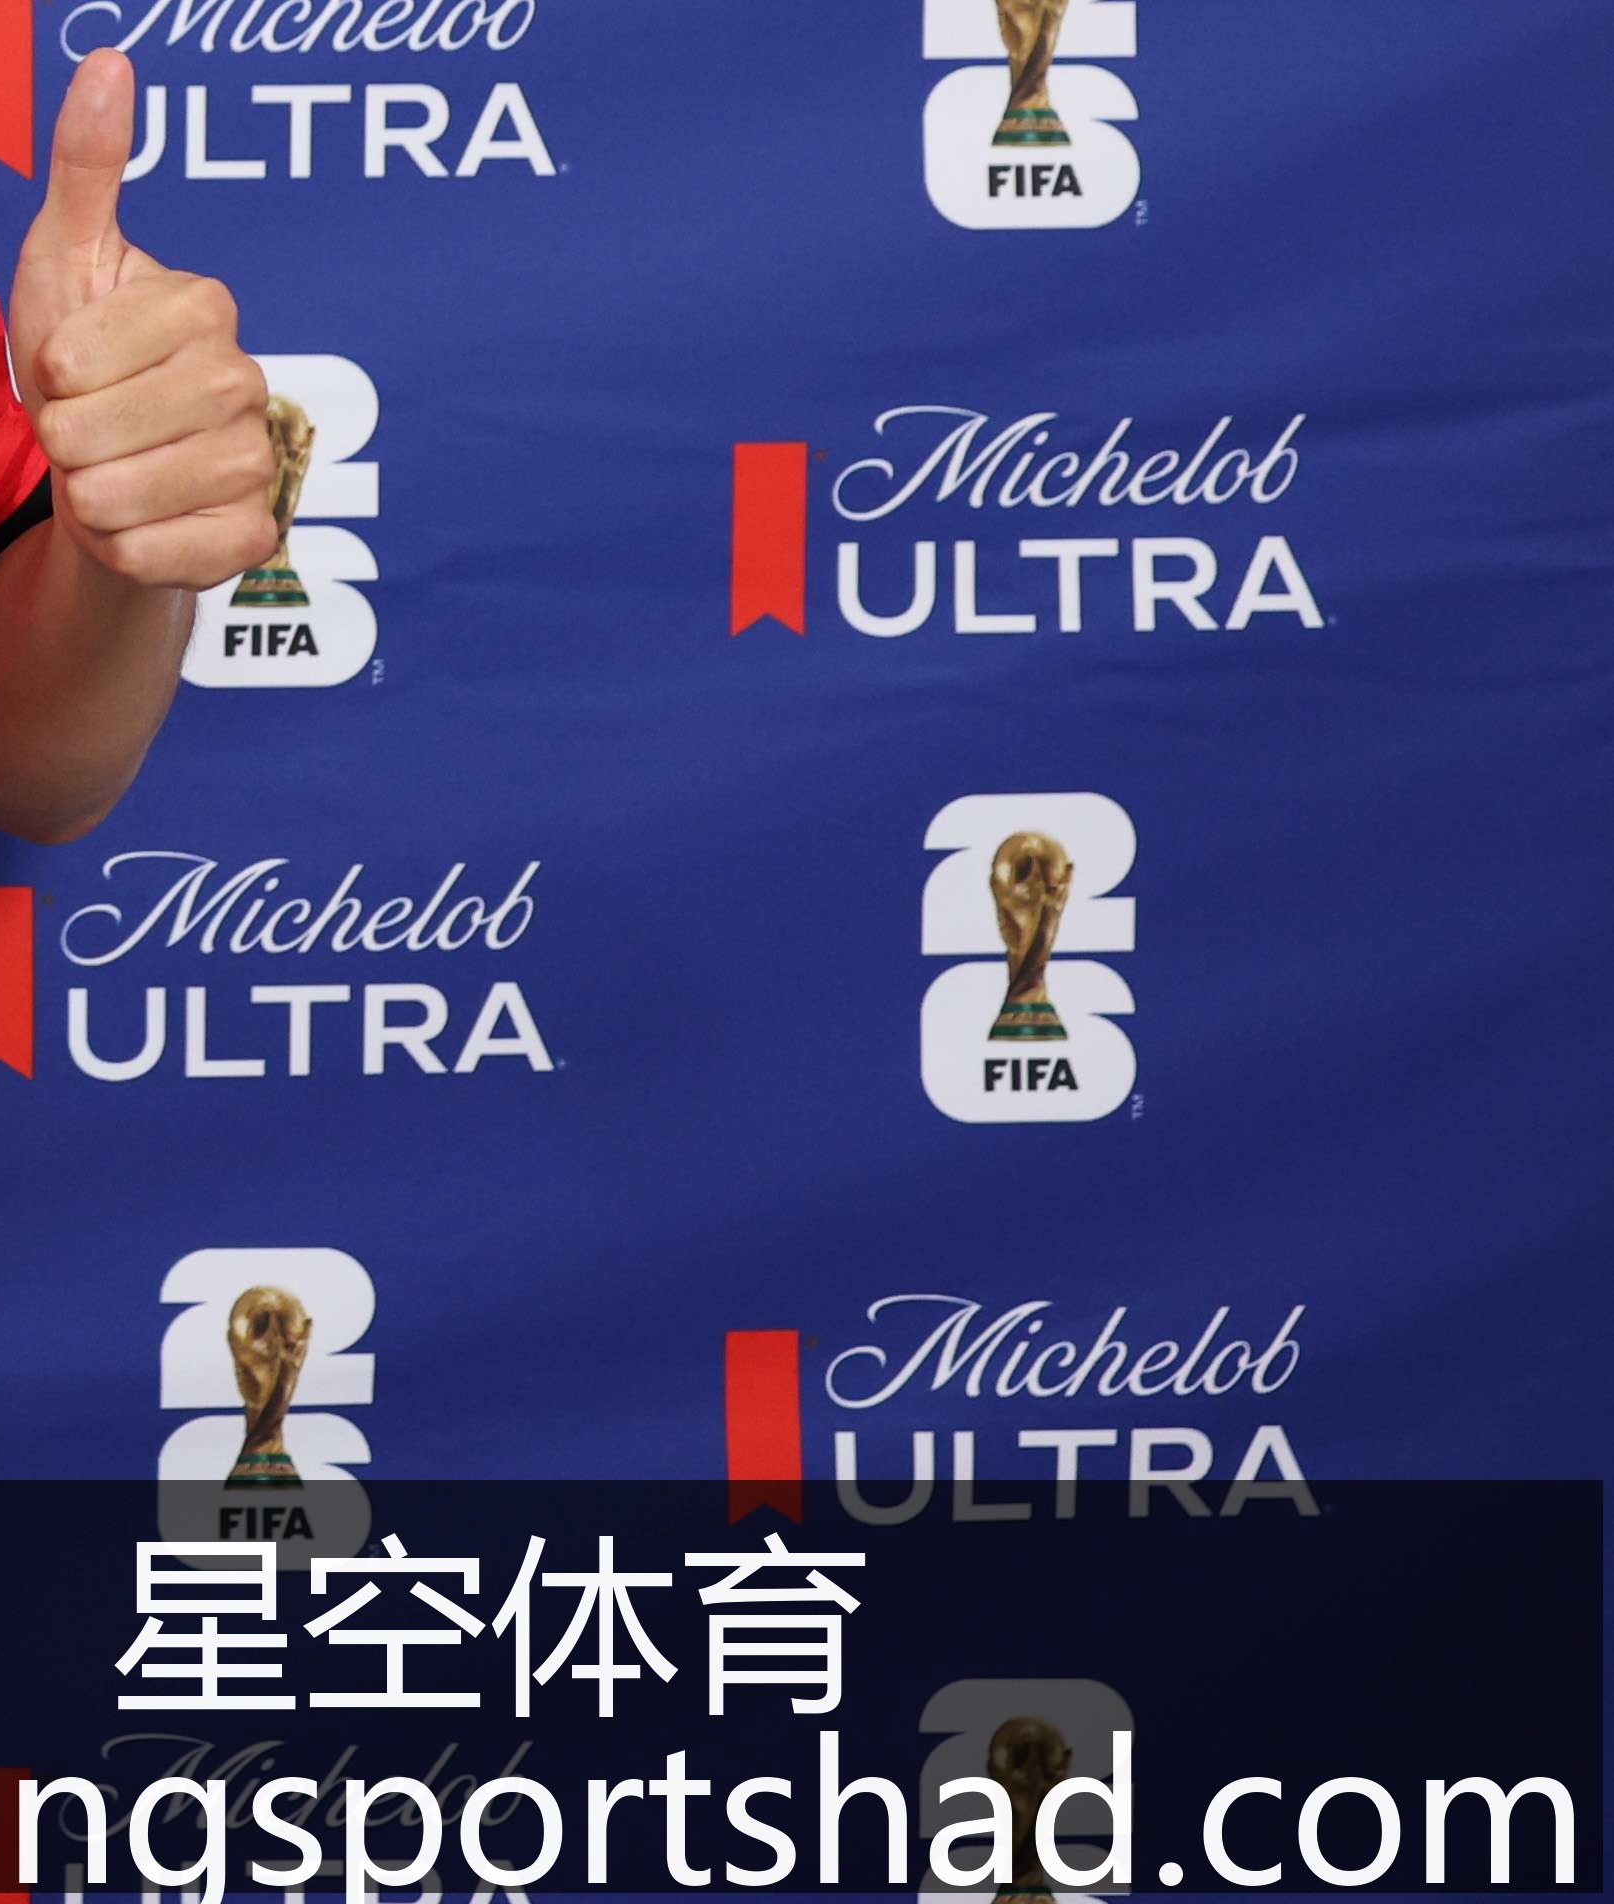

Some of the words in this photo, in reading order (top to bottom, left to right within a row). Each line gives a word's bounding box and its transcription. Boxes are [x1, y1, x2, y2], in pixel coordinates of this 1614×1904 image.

[988, 164, 1082, 198] FIFA
[832, 405, 1306, 521] Michelob
[837, 536, 1324, 638] ULTRA
[224, 623, 319, 657] FIFA
[60, 851, 540, 966] Michelob
[67, 982, 554, 1082] ULTRA
[984, 1058, 1079, 1092] FIFA
[825, 1294, 1306, 1409] Michelob
[219, 1506, 314, 1540] FIFA
[834, 1425, 1321, 1527] ULTRA
